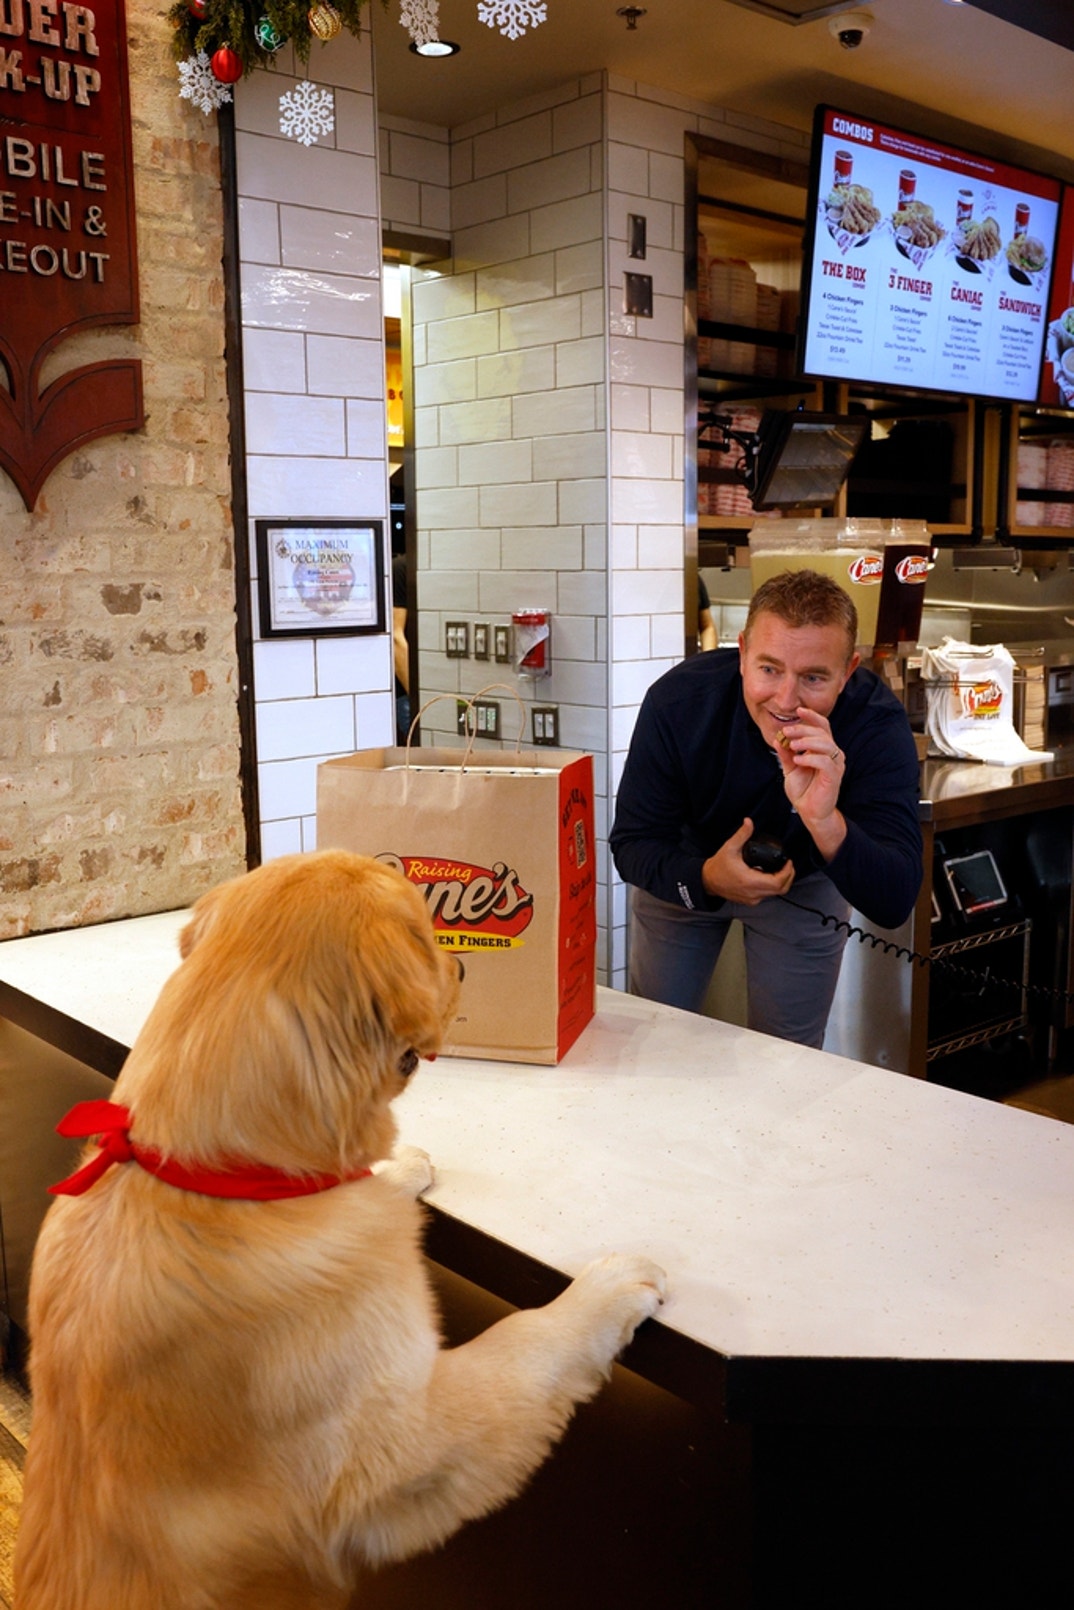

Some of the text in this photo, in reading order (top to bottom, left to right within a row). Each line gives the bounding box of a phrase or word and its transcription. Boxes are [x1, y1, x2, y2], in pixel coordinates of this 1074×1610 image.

[0, 46, 101, 107] K-UP
[832, 117, 874, 142] COMBOS
[0, 190, 108, 236] E-IN &
[0, 239, 110, 283] EOUT
[822, 260, 867, 283] THE BOX
[888, 274, 933, 295] 3 FINGER
[950, 287, 983, 306] CANIAC
[998, 296, 1042, 317] SANDWICH
[295, 540, 348, 550] MAXIMUM
[290, 552, 353, 564] OCCUPANCY
[407, 860, 473, 883] Raising
